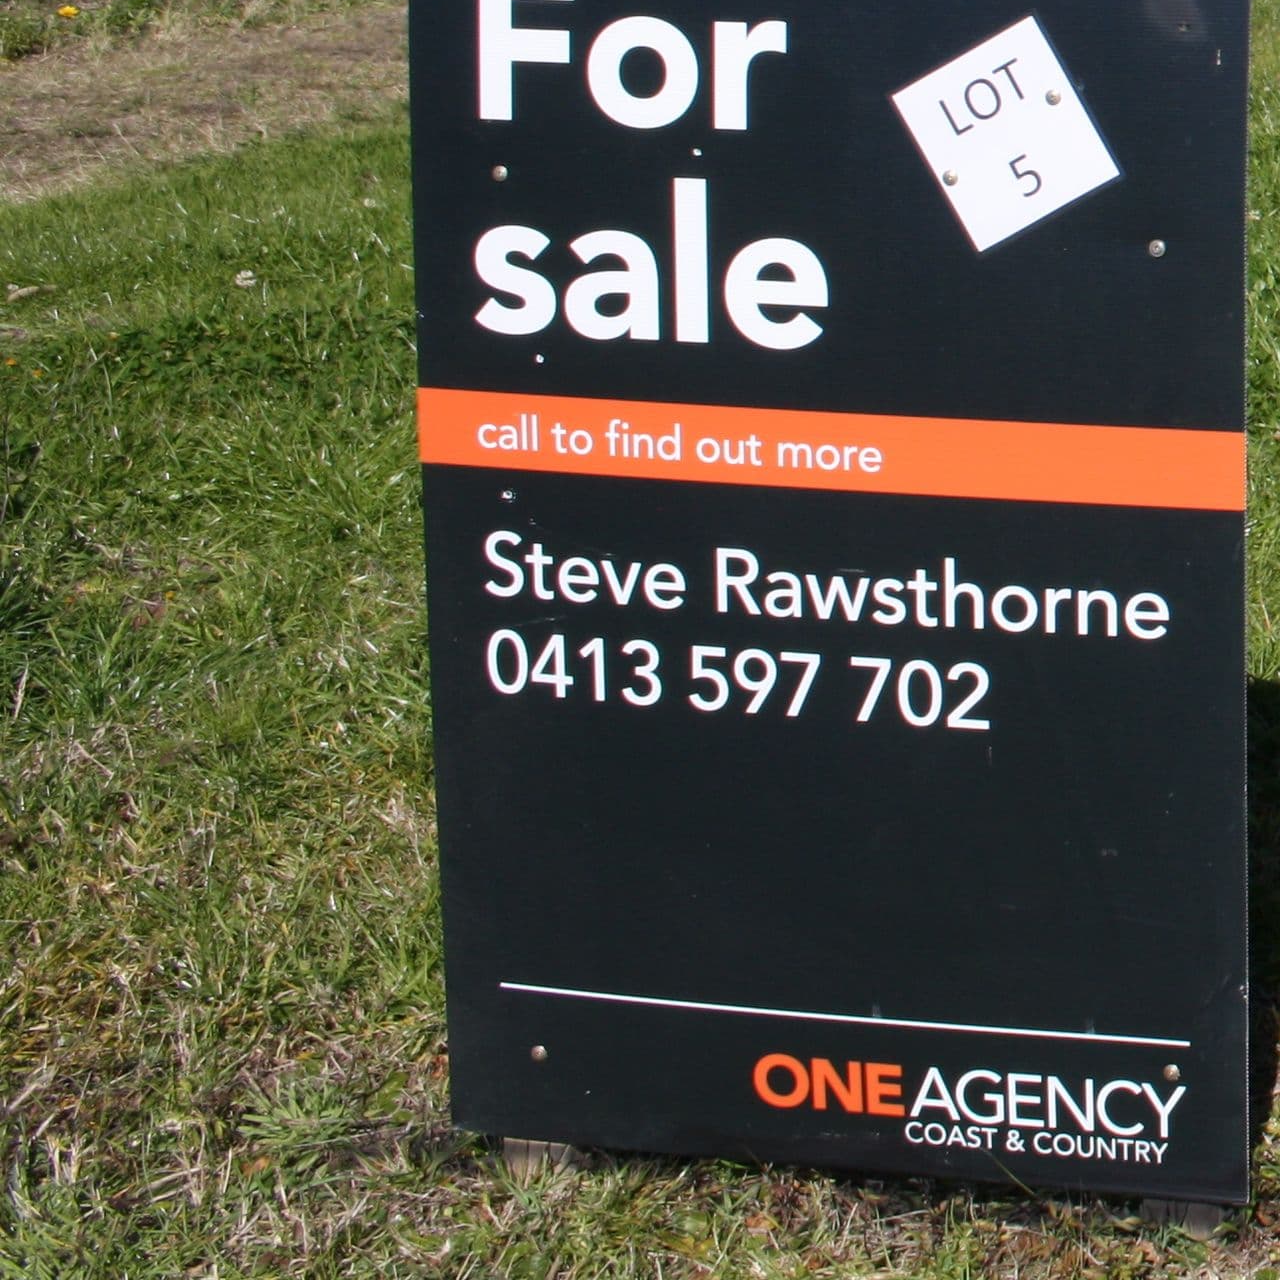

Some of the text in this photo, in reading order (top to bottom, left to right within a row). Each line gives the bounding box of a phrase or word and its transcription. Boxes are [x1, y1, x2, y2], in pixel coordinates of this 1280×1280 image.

[938, 58, 1025, 136] LOT
[1008, 154, 1042, 198] 5
[473, 177, 830, 351] sale
[477, 413, 884, 473] call to find out more
[484, 530, 1172, 640] Steve Rawsthorne
[486, 628, 991, 731] 0413 597 702
[752, 1052, 1188, 1139] ONE AGENCY
[904, 1121, 1169, 1164] COAST & COUNTRY
